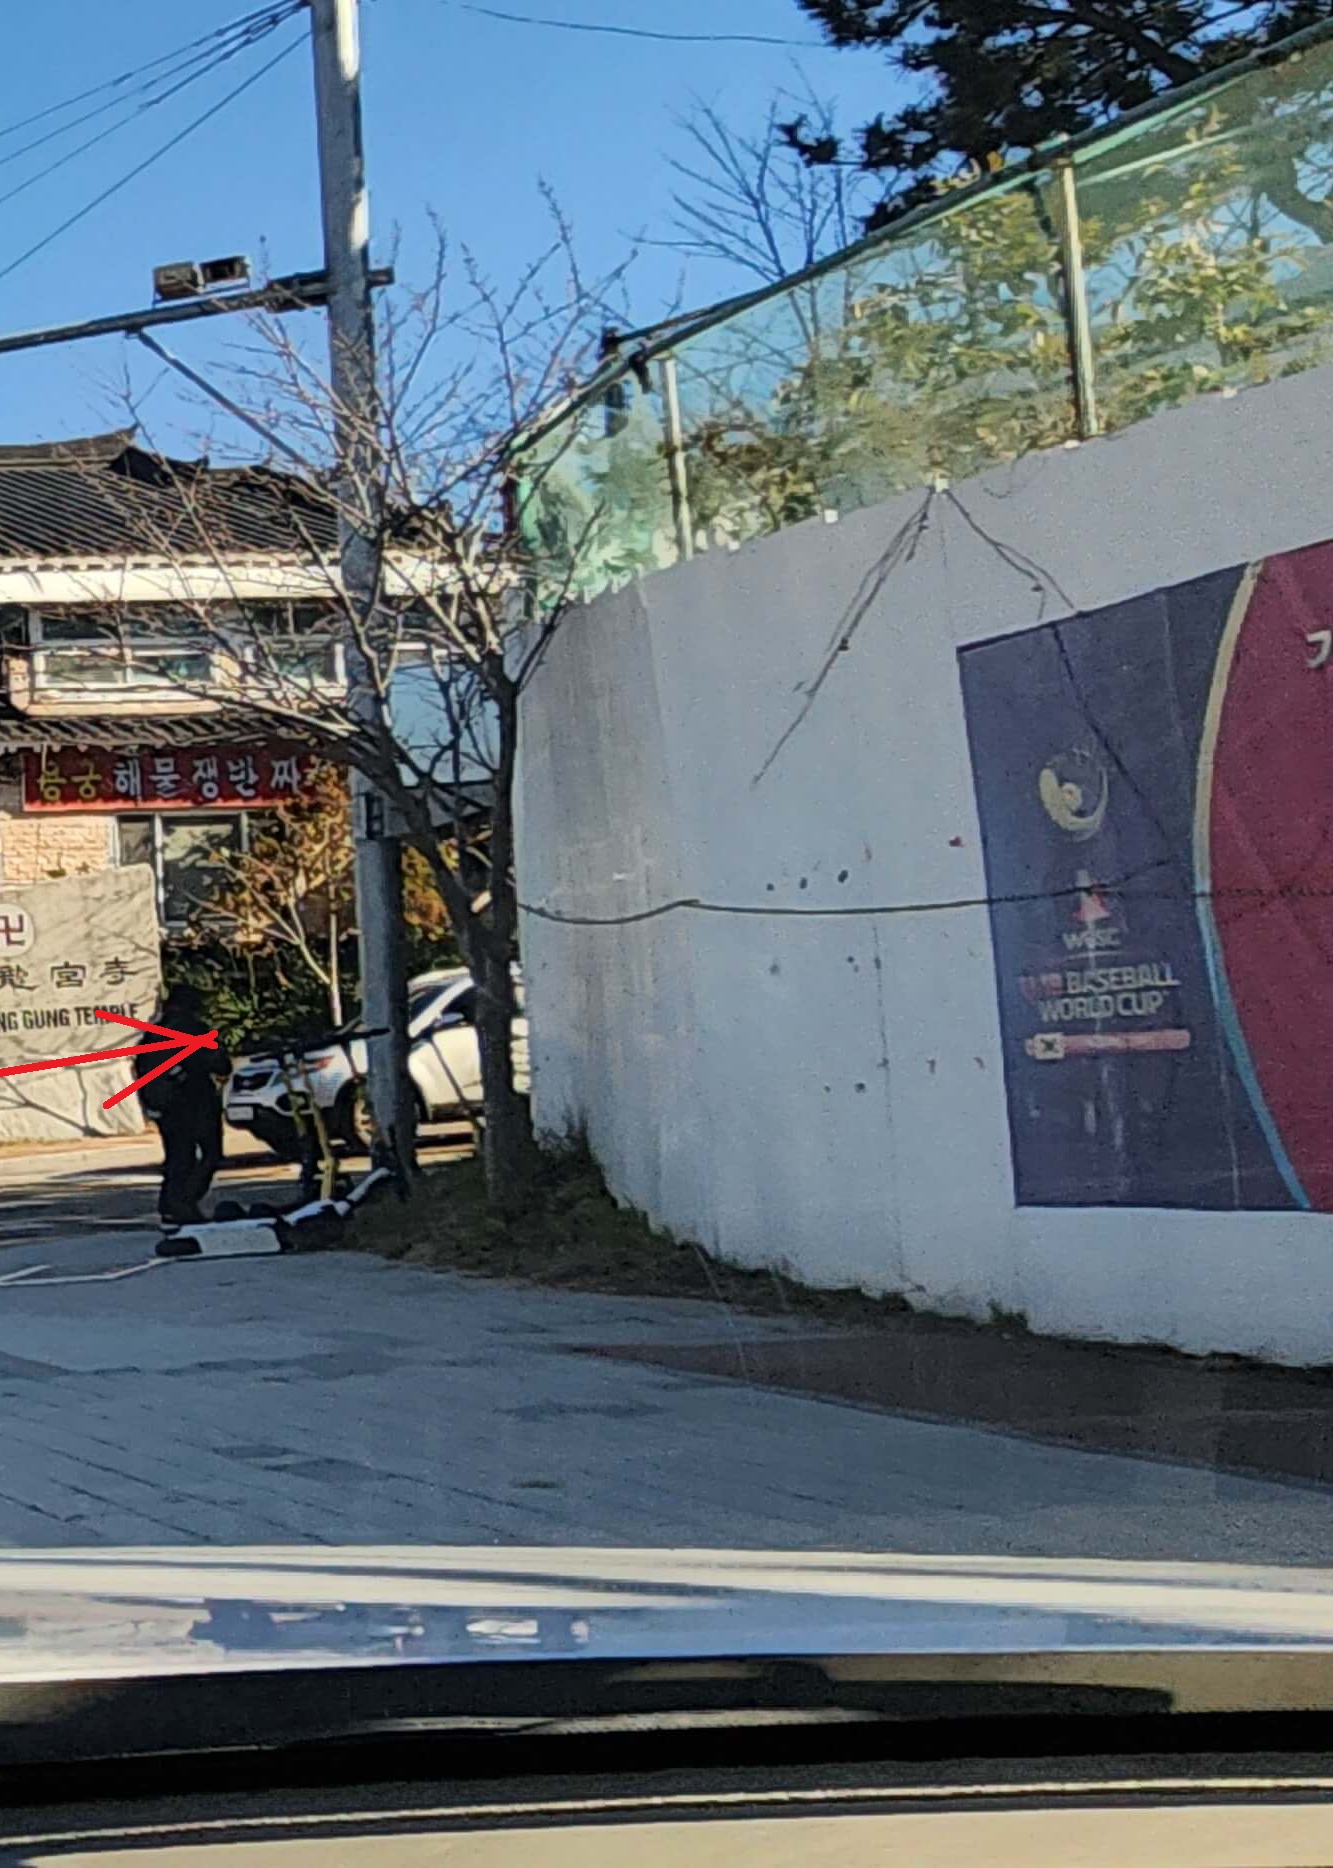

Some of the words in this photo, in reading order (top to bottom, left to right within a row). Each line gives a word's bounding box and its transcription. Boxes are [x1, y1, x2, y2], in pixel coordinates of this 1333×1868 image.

[1066, 962, 1181, 995] BASEBALL
[21, 1004, 70, 1030] GUNG
[1039, 995, 1114, 1022] WORLD
[1117, 990, 1165, 1017] CUP
